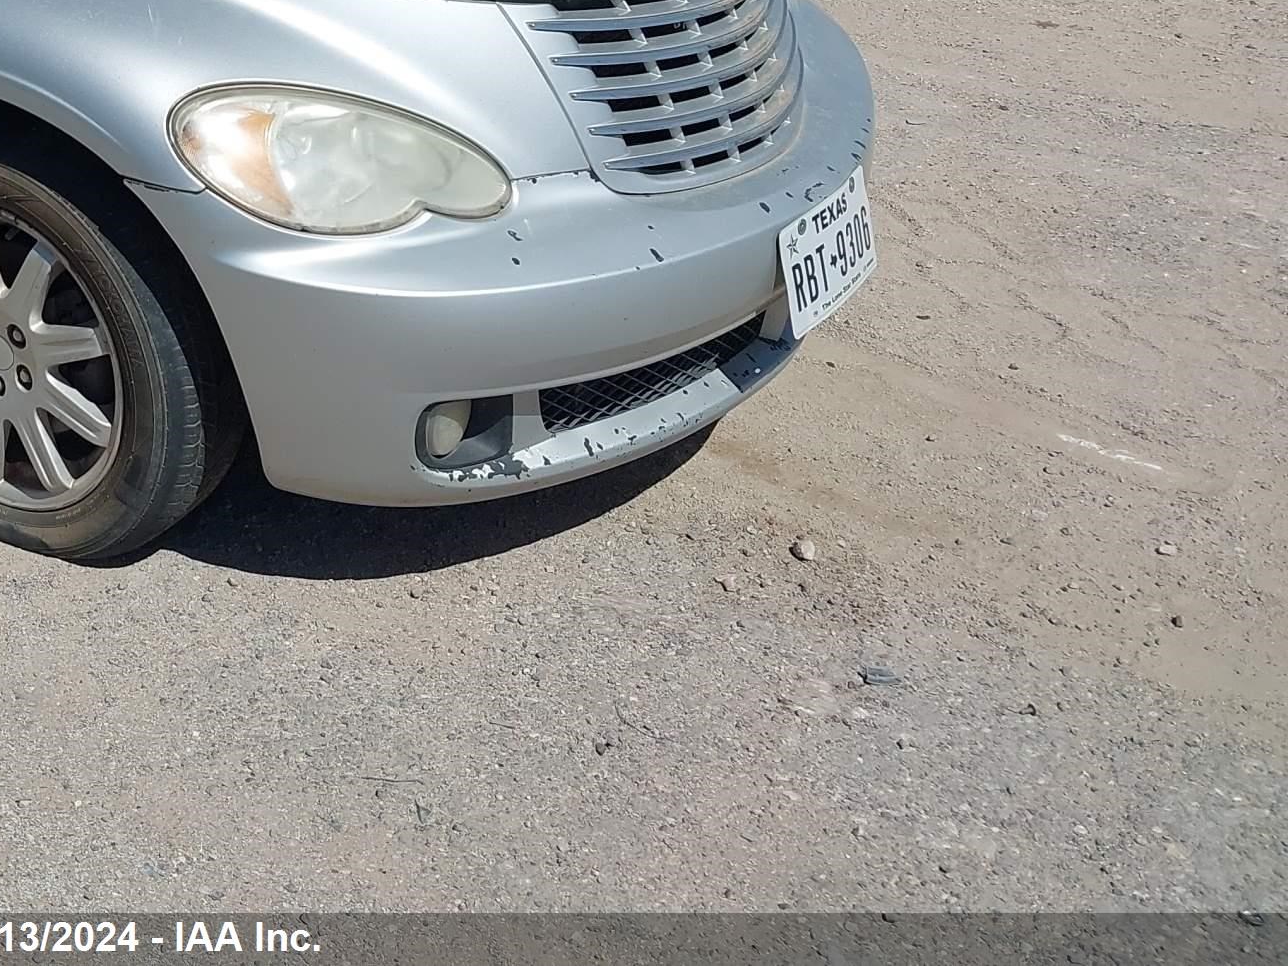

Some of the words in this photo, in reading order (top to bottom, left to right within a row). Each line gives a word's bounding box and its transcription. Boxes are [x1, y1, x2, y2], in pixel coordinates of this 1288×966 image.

[812, 192, 848, 234] TEXAS
[792, 244, 829, 313] RBT
[836, 205, 871, 276] 9306
[822, 300, 832, 311] The
[832, 291, 843, 303] Lone
[842, 282, 852, 293] Star
